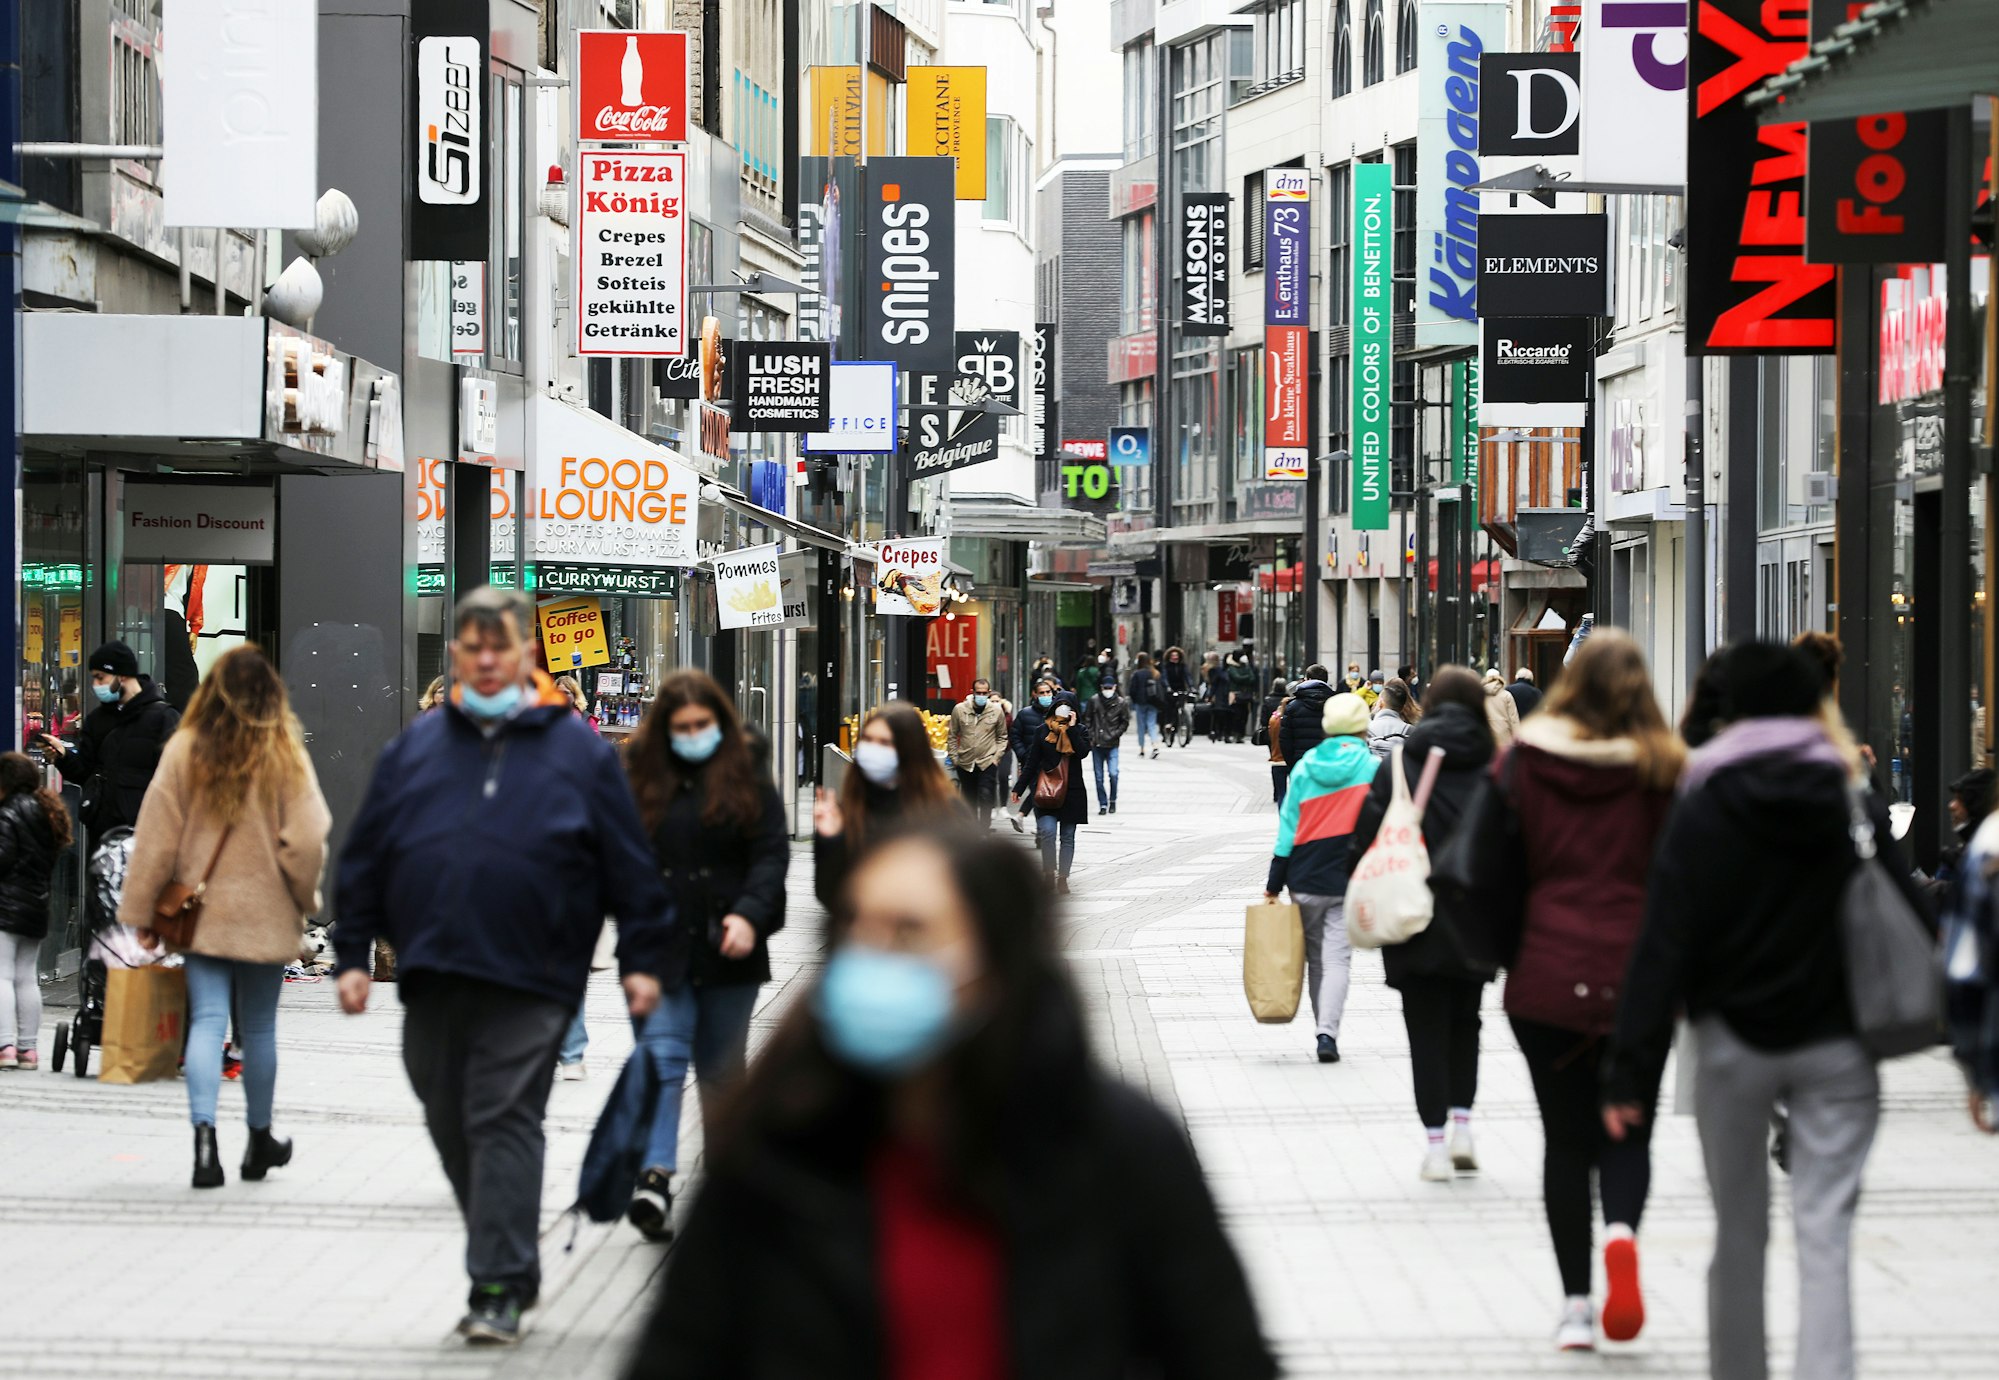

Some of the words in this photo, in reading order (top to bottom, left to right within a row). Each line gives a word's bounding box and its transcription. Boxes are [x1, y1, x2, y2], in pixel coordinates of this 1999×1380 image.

[595, 105, 671, 132] Coca-Cola
[935, 73, 950, 156] CCITANE
[592, 160, 673, 182] Pizza
[1276, 173, 1303, 189] dm
[586, 191, 679, 218] König
[1273, 207, 1300, 237] 73
[598, 229, 666, 246] Crepes
[1213, 204, 1226, 282] MONDE
[1363, 193, 1382, 299] BENETTON.
[600, 252, 663, 267] Brezel
[1186, 204, 1208, 324] MAISONS
[1484, 257, 1599, 274] ELEMENTS
[597, 276, 666, 291] Softeis
[881, 203, 939, 345] snipes
[1275, 237, 1292, 319] Eventhaus
[587, 300, 676, 317] gekühlte
[1213, 298, 1226, 324] DU
[584, 323, 679, 338] Getränke
[1363, 306, 1381, 335] OF
[748, 355, 820, 375] LUSH
[1282, 330, 1295, 385] Steakhaus
[748, 377, 820, 394] FRESH
[1362, 341, 1381, 423] COLORS
[748, 396, 820, 407] HANDMADE
[1282, 386, 1295, 418] kleine
[748, 408, 820, 420] COSMETICS
[828, 417, 886, 430] FFICE
[1282, 419, 1295, 442] Das
[914, 439, 993, 471] Belgique
[1064, 441, 1105, 458] REWE
[1274, 452, 1302, 468] dm
[560, 456, 669, 491] FOOD
[1362, 431, 1380, 502] UNITED
[540, 487, 688, 525] LOUNGE
[131, 511, 192, 528] Fashion
[196, 513, 265, 530] Discount
[613, 526, 681, 542] POMMES
[535, 538, 639, 557] CURRYWURST
[646, 543, 689, 559] PIZZA
[717, 560, 777, 580] Pommes
[546, 610, 597, 629] Coffee
[751, 611, 782, 626] Frites
[784, 602, 806, 619] urst
[1222, 592, 1233, 635] SALE
[549, 632, 566, 645] to
[573, 627, 595, 644] go
[926, 623, 970, 658] ALE
